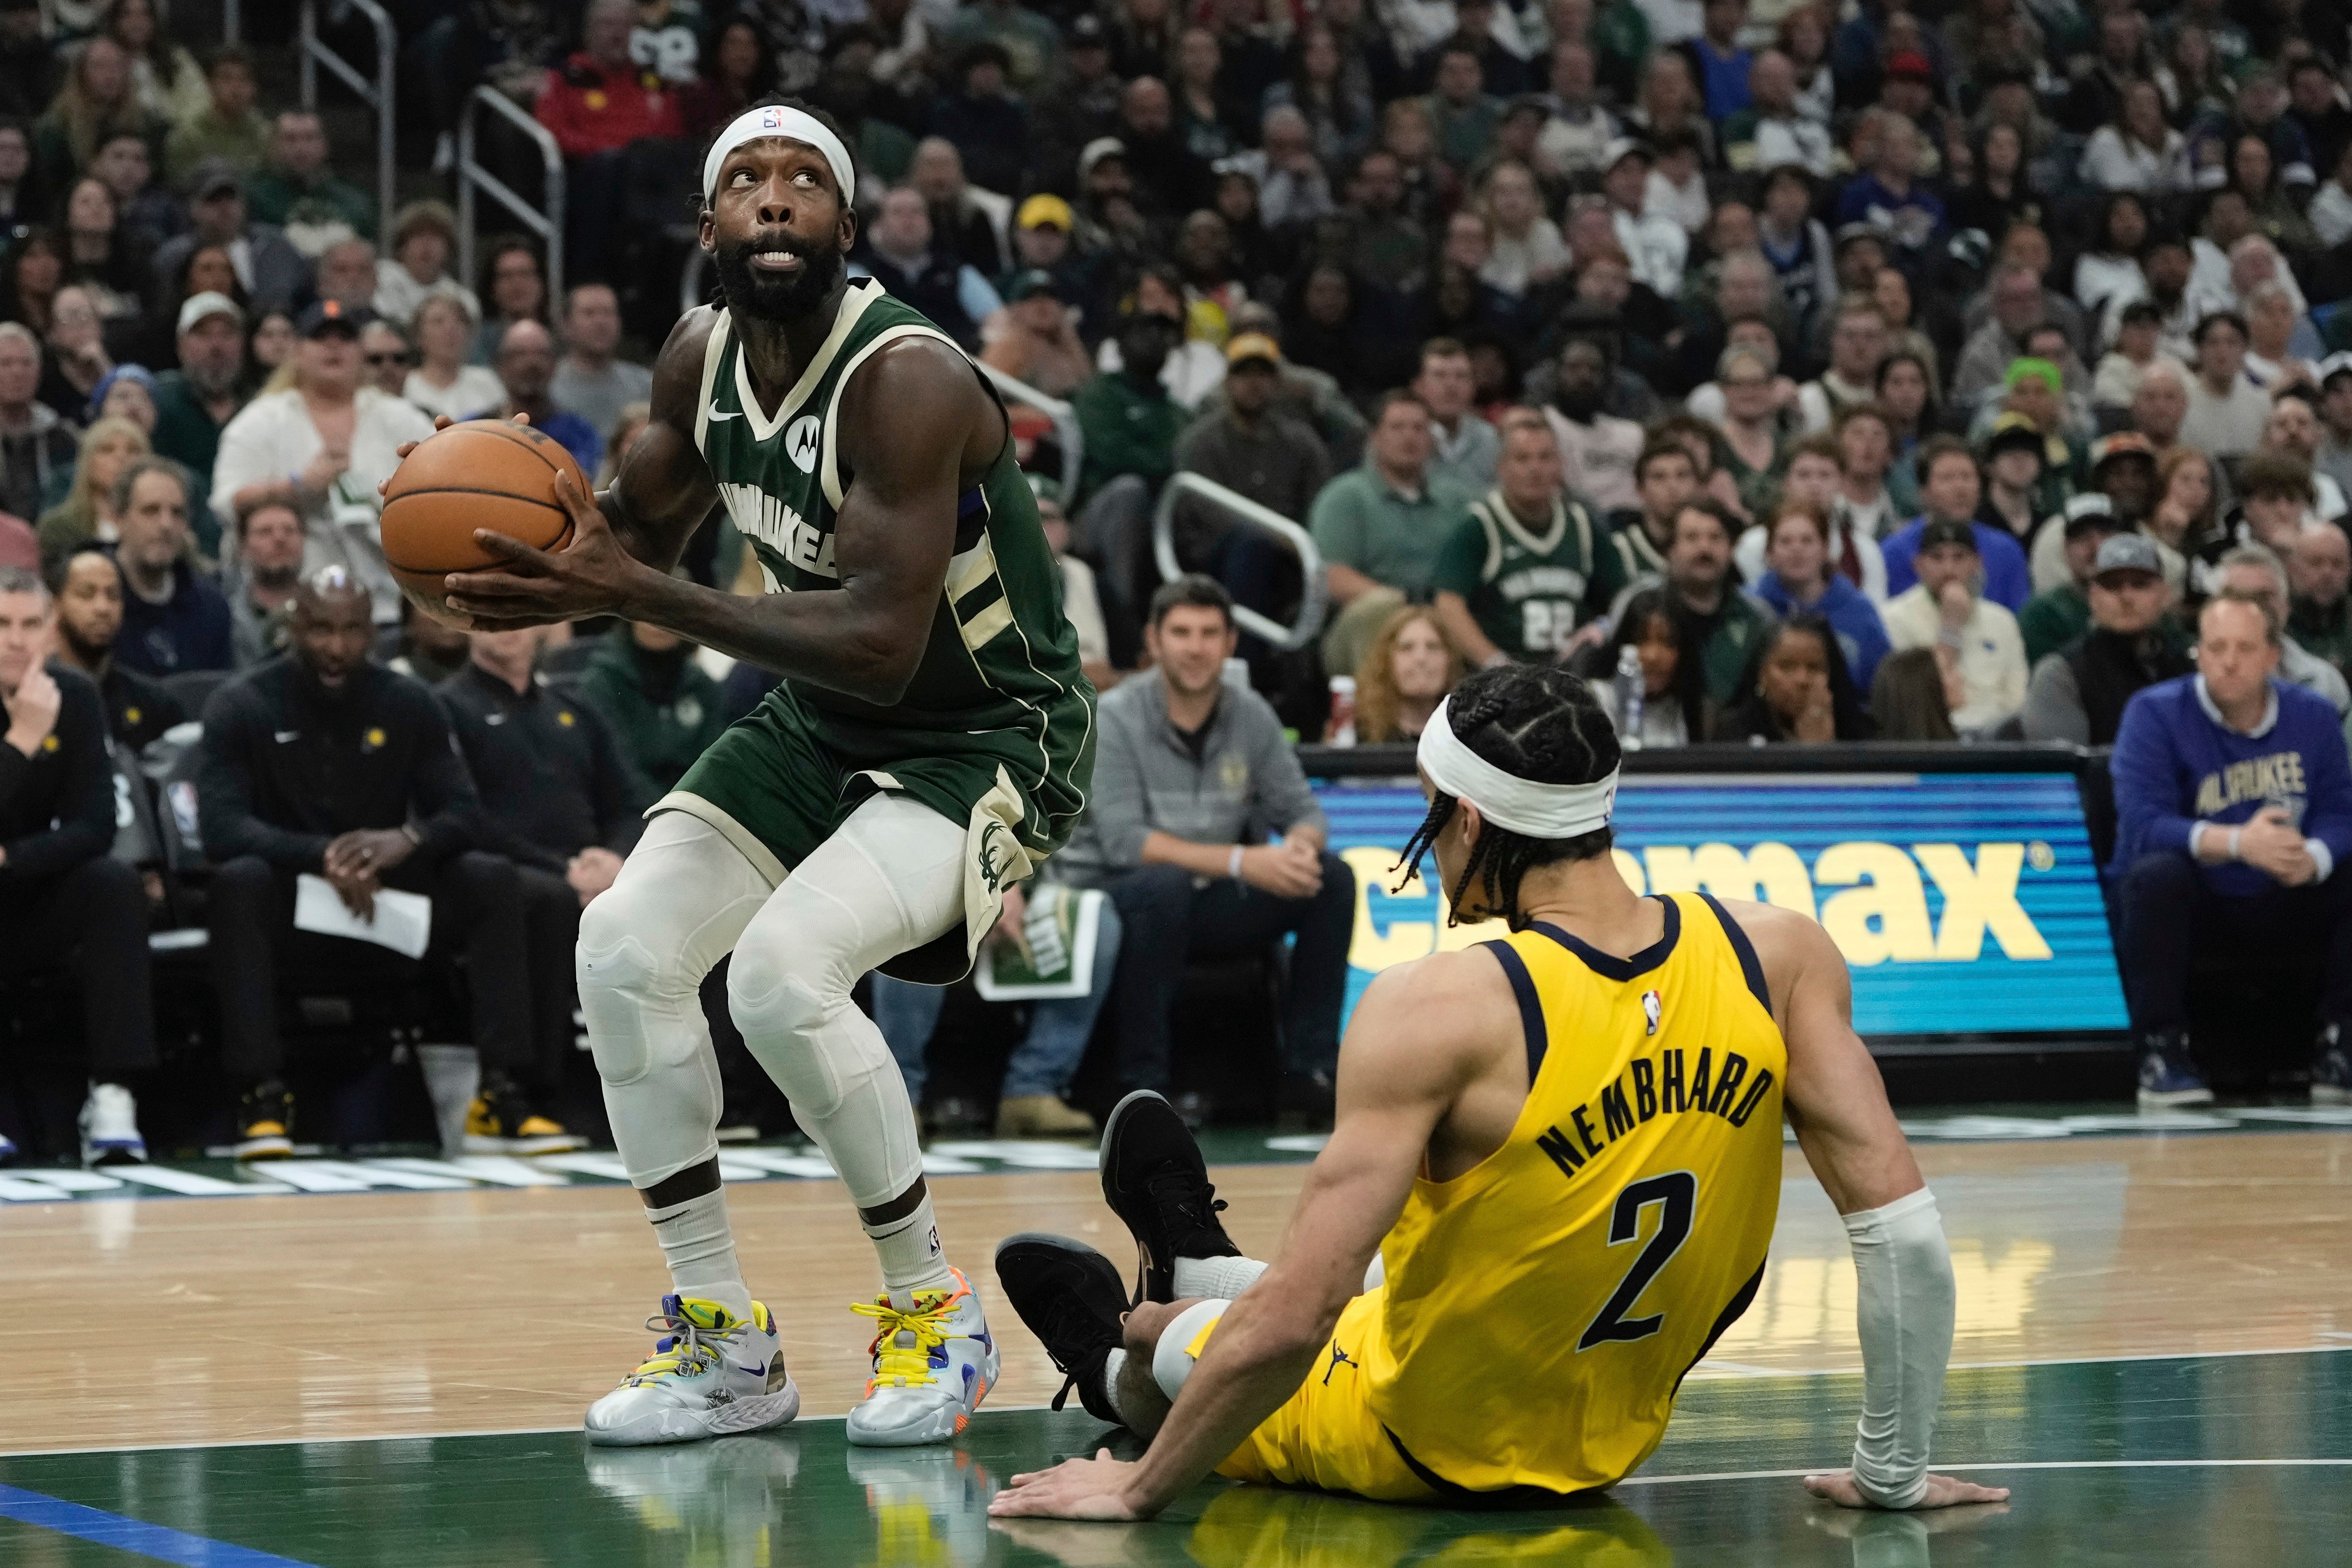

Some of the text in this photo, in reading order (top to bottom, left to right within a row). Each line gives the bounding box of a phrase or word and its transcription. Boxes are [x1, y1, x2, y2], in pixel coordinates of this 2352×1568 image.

[715, 482, 838, 579] ILWAUKEE
[1339, 841, 2054, 973] cmax
[1536, 1047, 1774, 1179] NEMBHARD
[1576, 1168, 1699, 1354] 2
